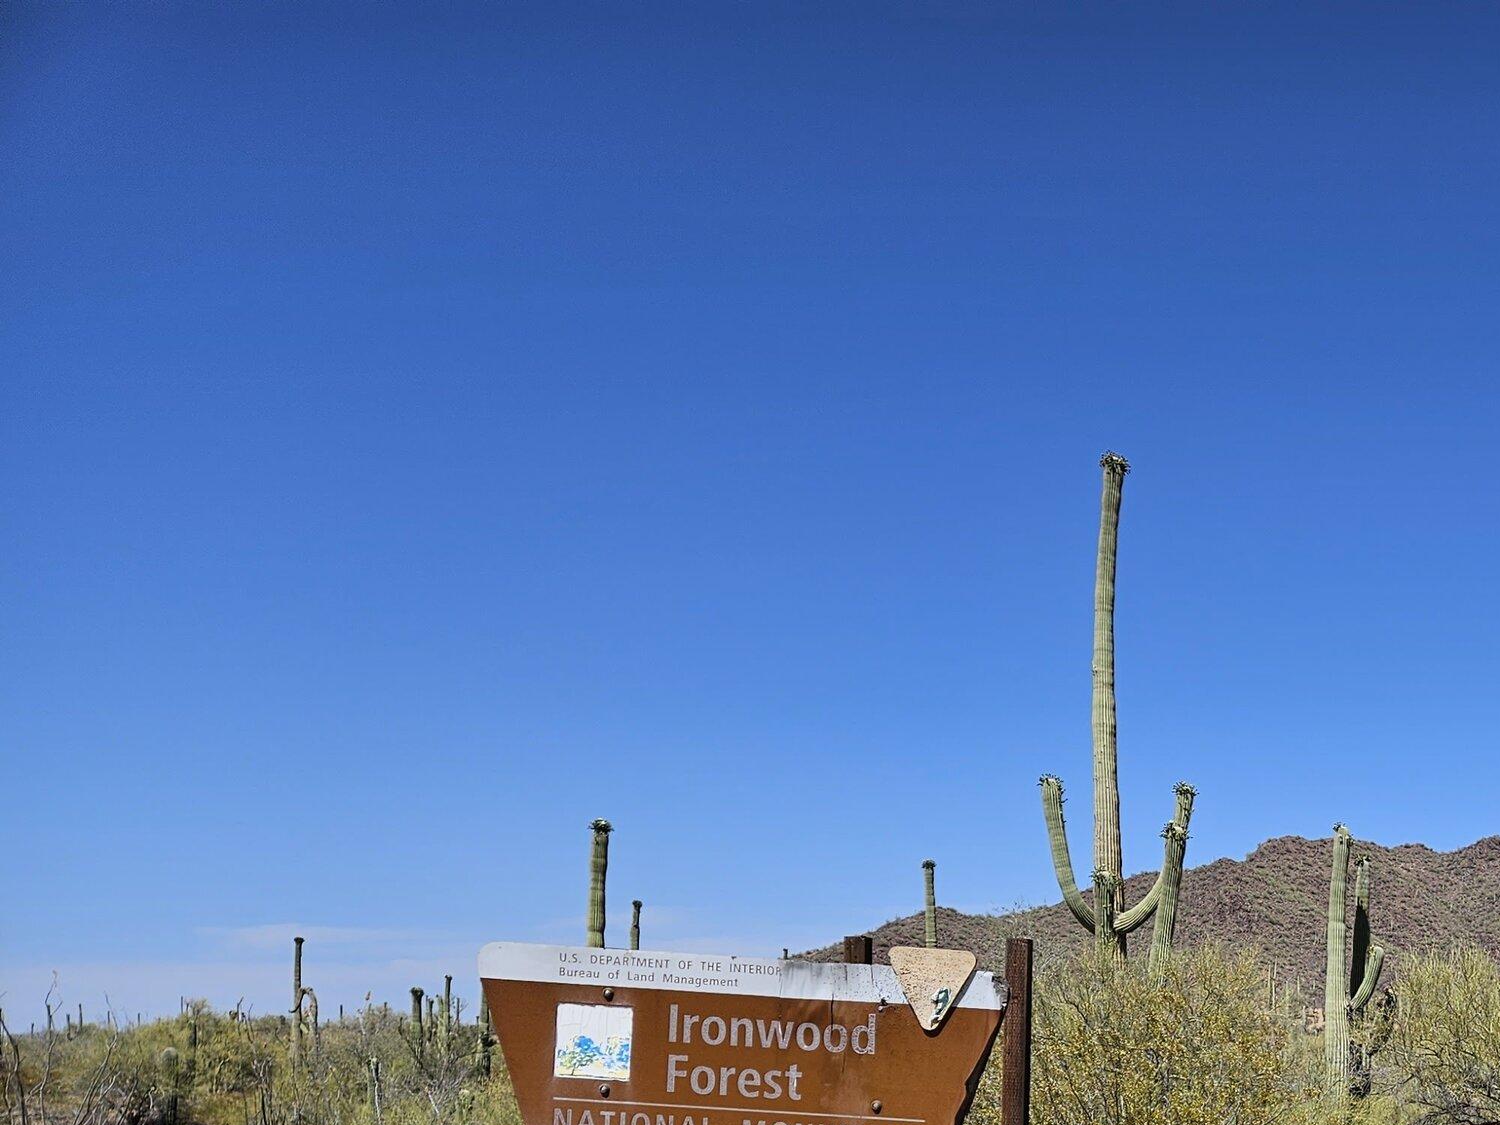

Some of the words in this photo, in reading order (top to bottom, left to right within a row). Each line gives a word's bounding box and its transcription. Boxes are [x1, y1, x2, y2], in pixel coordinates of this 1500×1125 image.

[559, 953, 582, 964] U.S.
[590, 954, 670, 969] DEPARTMENT
[678, 959, 693, 971] OF
[701, 961, 722, 972] THE
[729, 963, 782, 976] INTERIOR
[559, 967, 600, 979] Bureau
[607, 970, 620, 980] of
[627, 971, 655, 982] Land
[662, 973, 738, 988] Management
[668, 1003, 876, 1055] Ironwood
[666, 1053, 803, 1101] Forest
